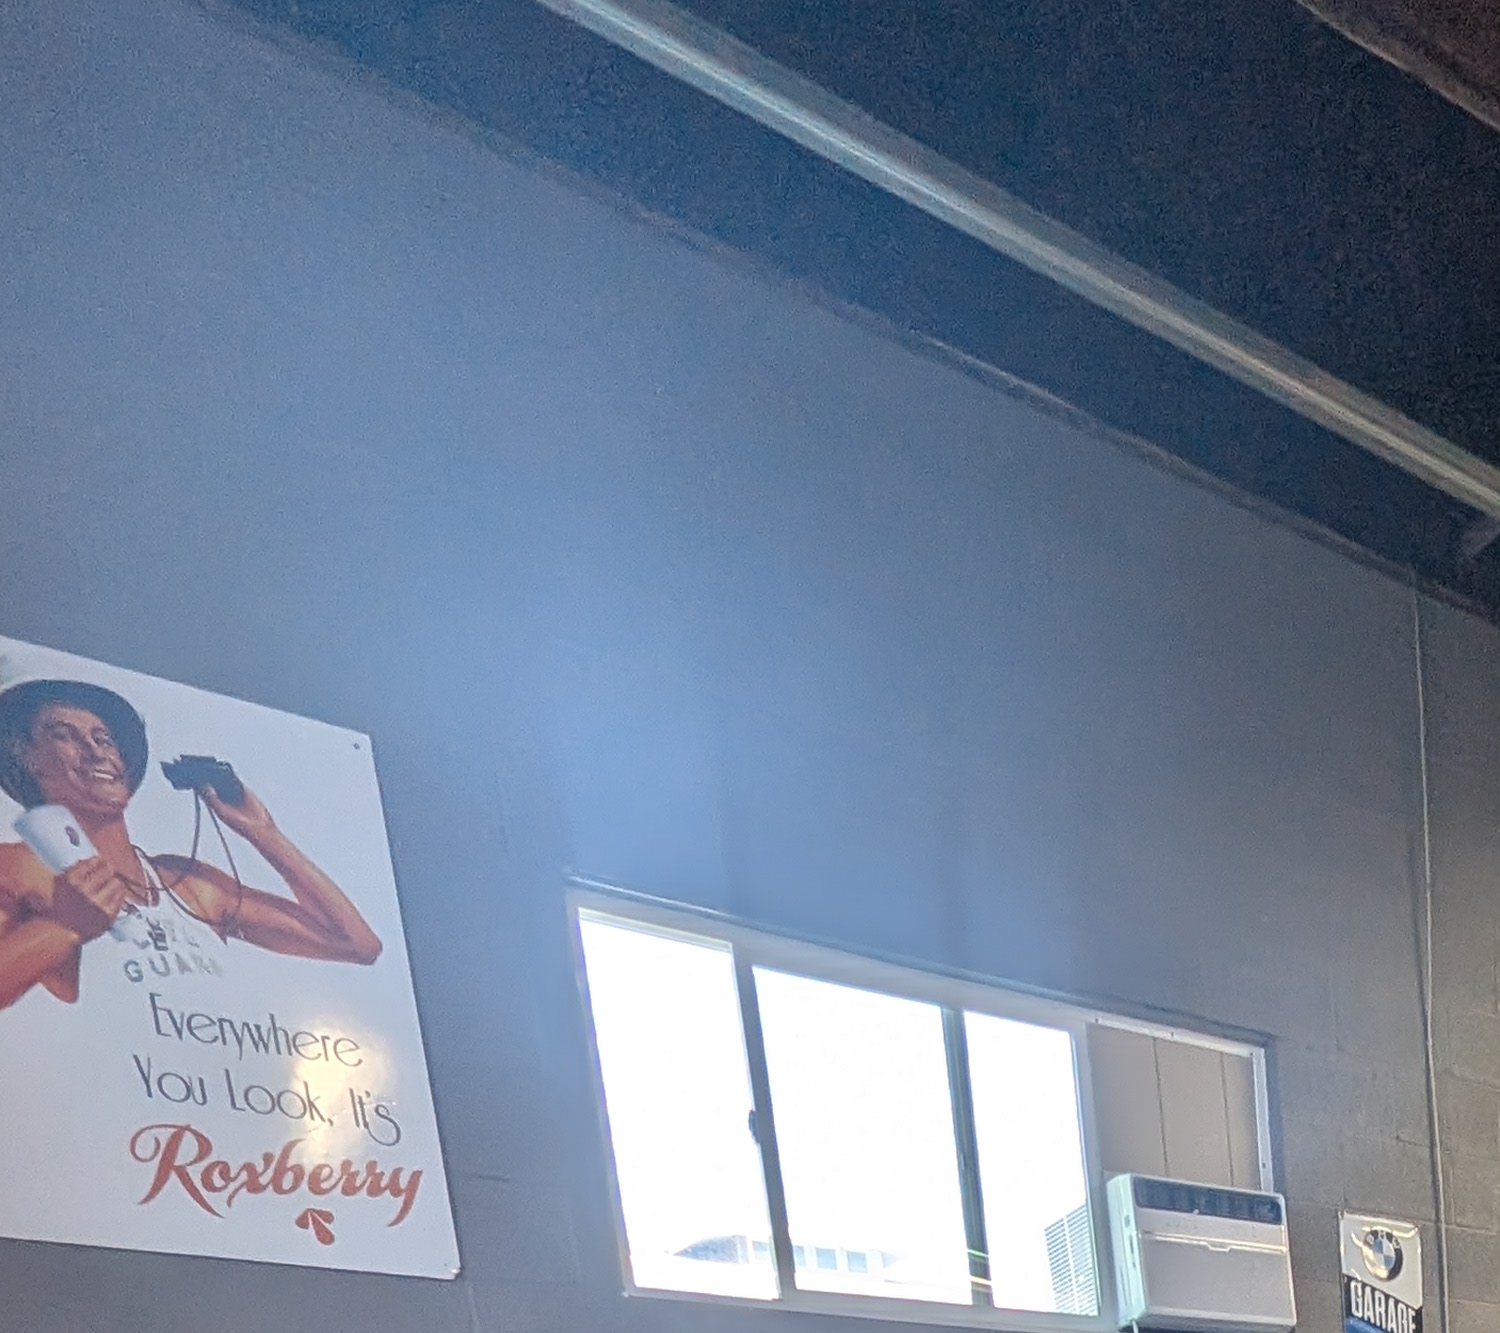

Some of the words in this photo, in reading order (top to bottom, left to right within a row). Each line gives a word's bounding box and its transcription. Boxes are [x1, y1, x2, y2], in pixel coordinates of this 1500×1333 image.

[149, 992, 363, 1067] Everywhere
[133, 1054, 208, 1107] You
[224, 1067, 334, 1127] Look,
[349, 1087, 401, 1147] It's
[129, 1123, 424, 1227] Roxberry
